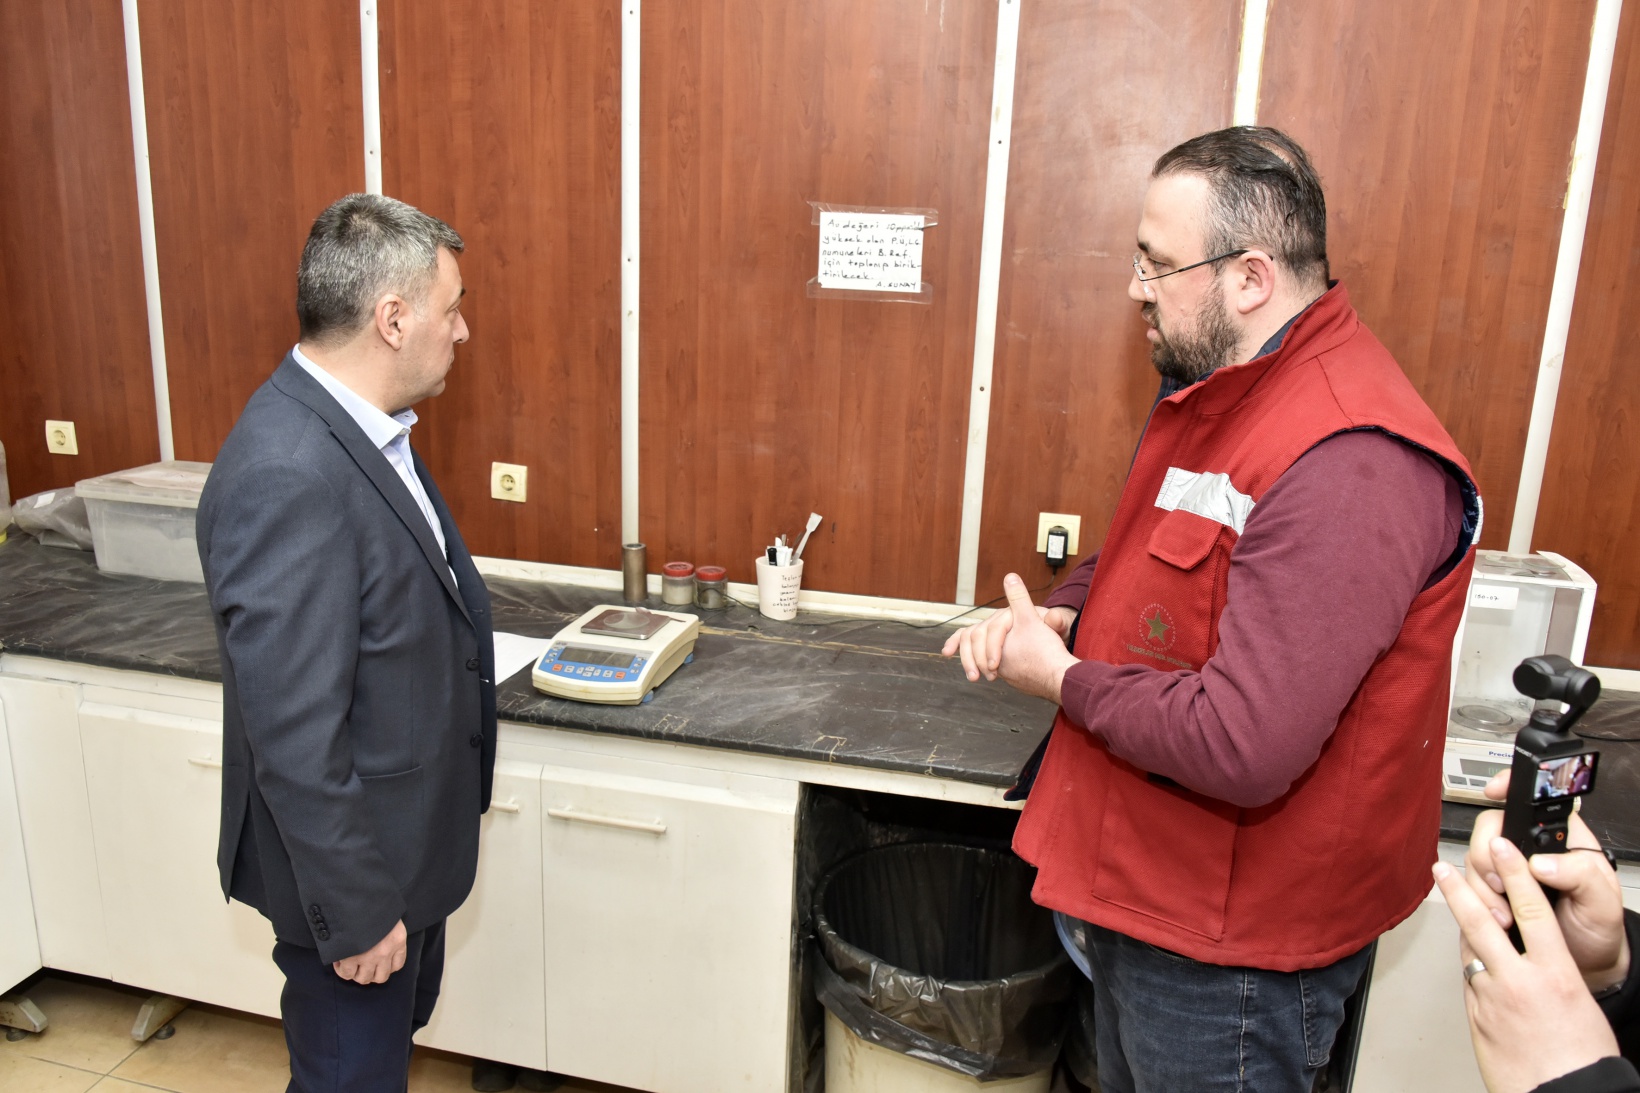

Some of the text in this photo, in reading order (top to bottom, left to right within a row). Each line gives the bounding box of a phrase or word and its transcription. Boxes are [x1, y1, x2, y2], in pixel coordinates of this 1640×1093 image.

[842, 220, 879, 232] değeri
[822, 233, 863, 245] yüksek
[866, 235, 885, 244] olan
[822, 247, 872, 256] numuneleri
[823, 258, 841, 269] için
